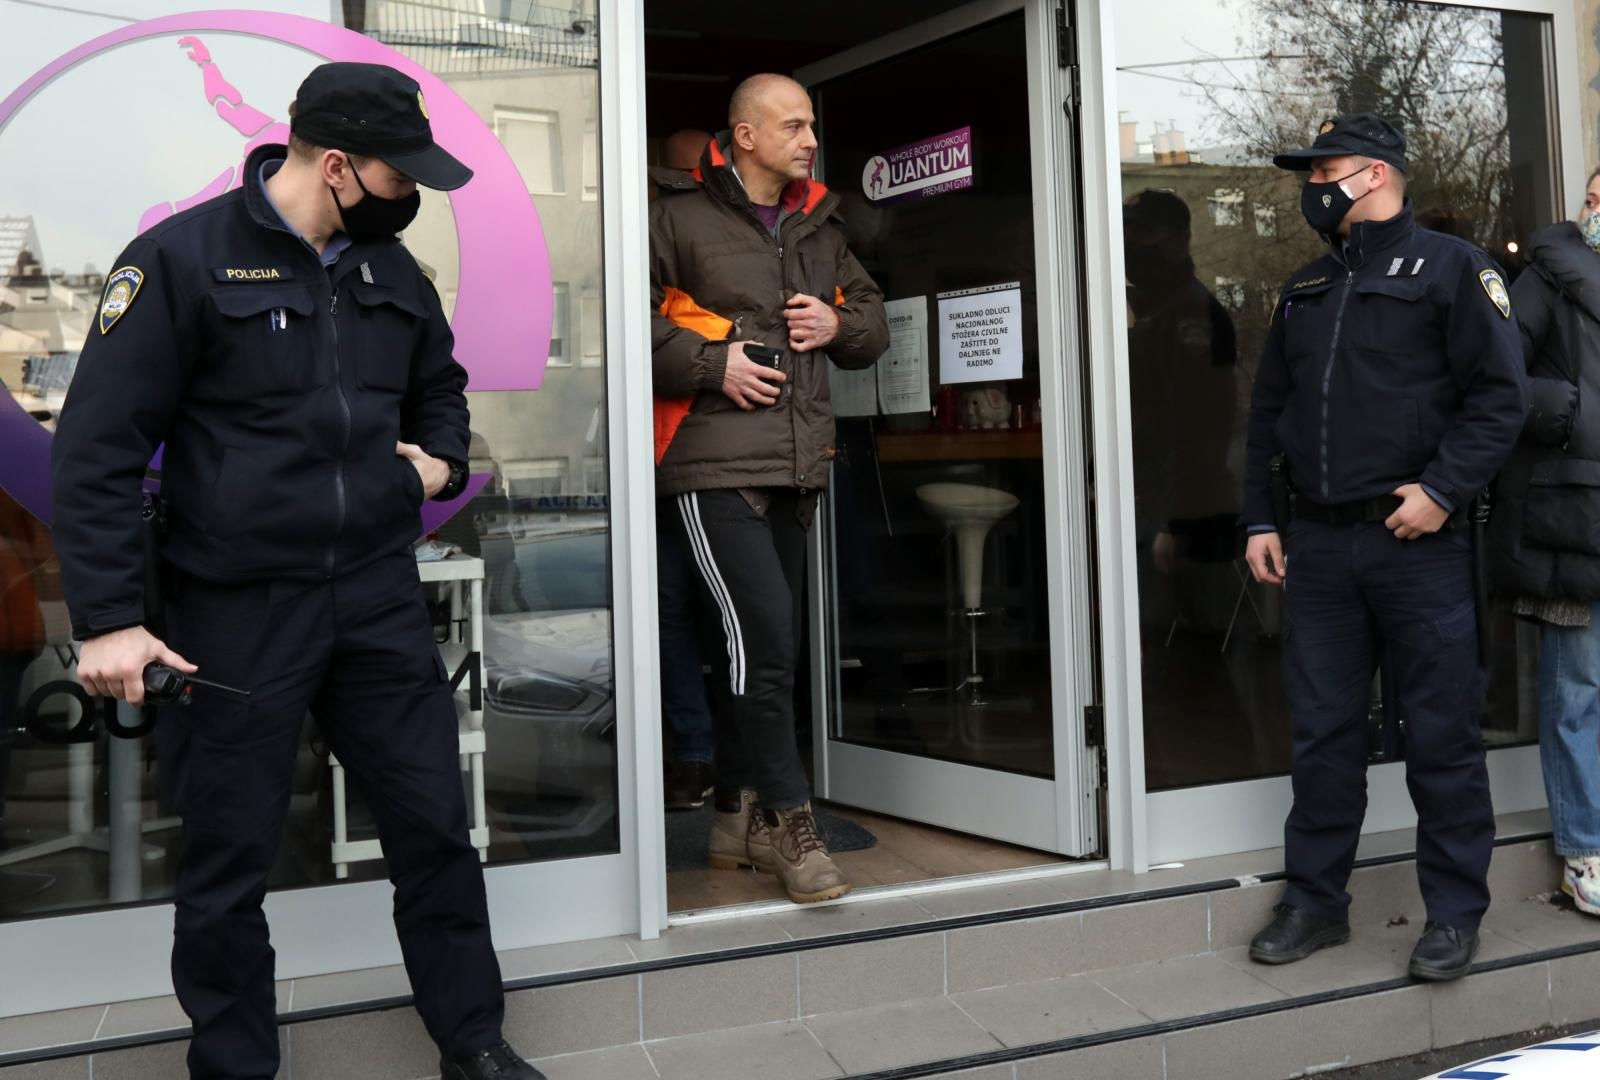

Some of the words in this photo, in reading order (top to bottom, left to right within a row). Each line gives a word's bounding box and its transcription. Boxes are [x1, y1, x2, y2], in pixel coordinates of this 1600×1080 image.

[890, 150, 913, 163] WHOLE
[914, 143, 932, 156] BODY
[933, 132, 969, 150] WORKOUT
[922, 181, 953, 197] PREMIUM
[954, 177, 971, 190] GYM
[226, 268, 280, 279] POLICIJA
[948, 310, 984, 321] SUKLADNO
[985, 306, 1010, 316] ODLUCI
[955, 317, 1004, 329] NACIONALNOG
[951, 329, 980, 340] STOŽERA
[981, 326, 1009, 336] CIVILNE
[960, 338, 987, 348] ZAŠTITE
[988, 338, 999, 346] DO
[958, 349, 991, 358] DALJNJEG
[992, 347, 1001, 355] NE
[966, 358, 994, 367] RADIMO
